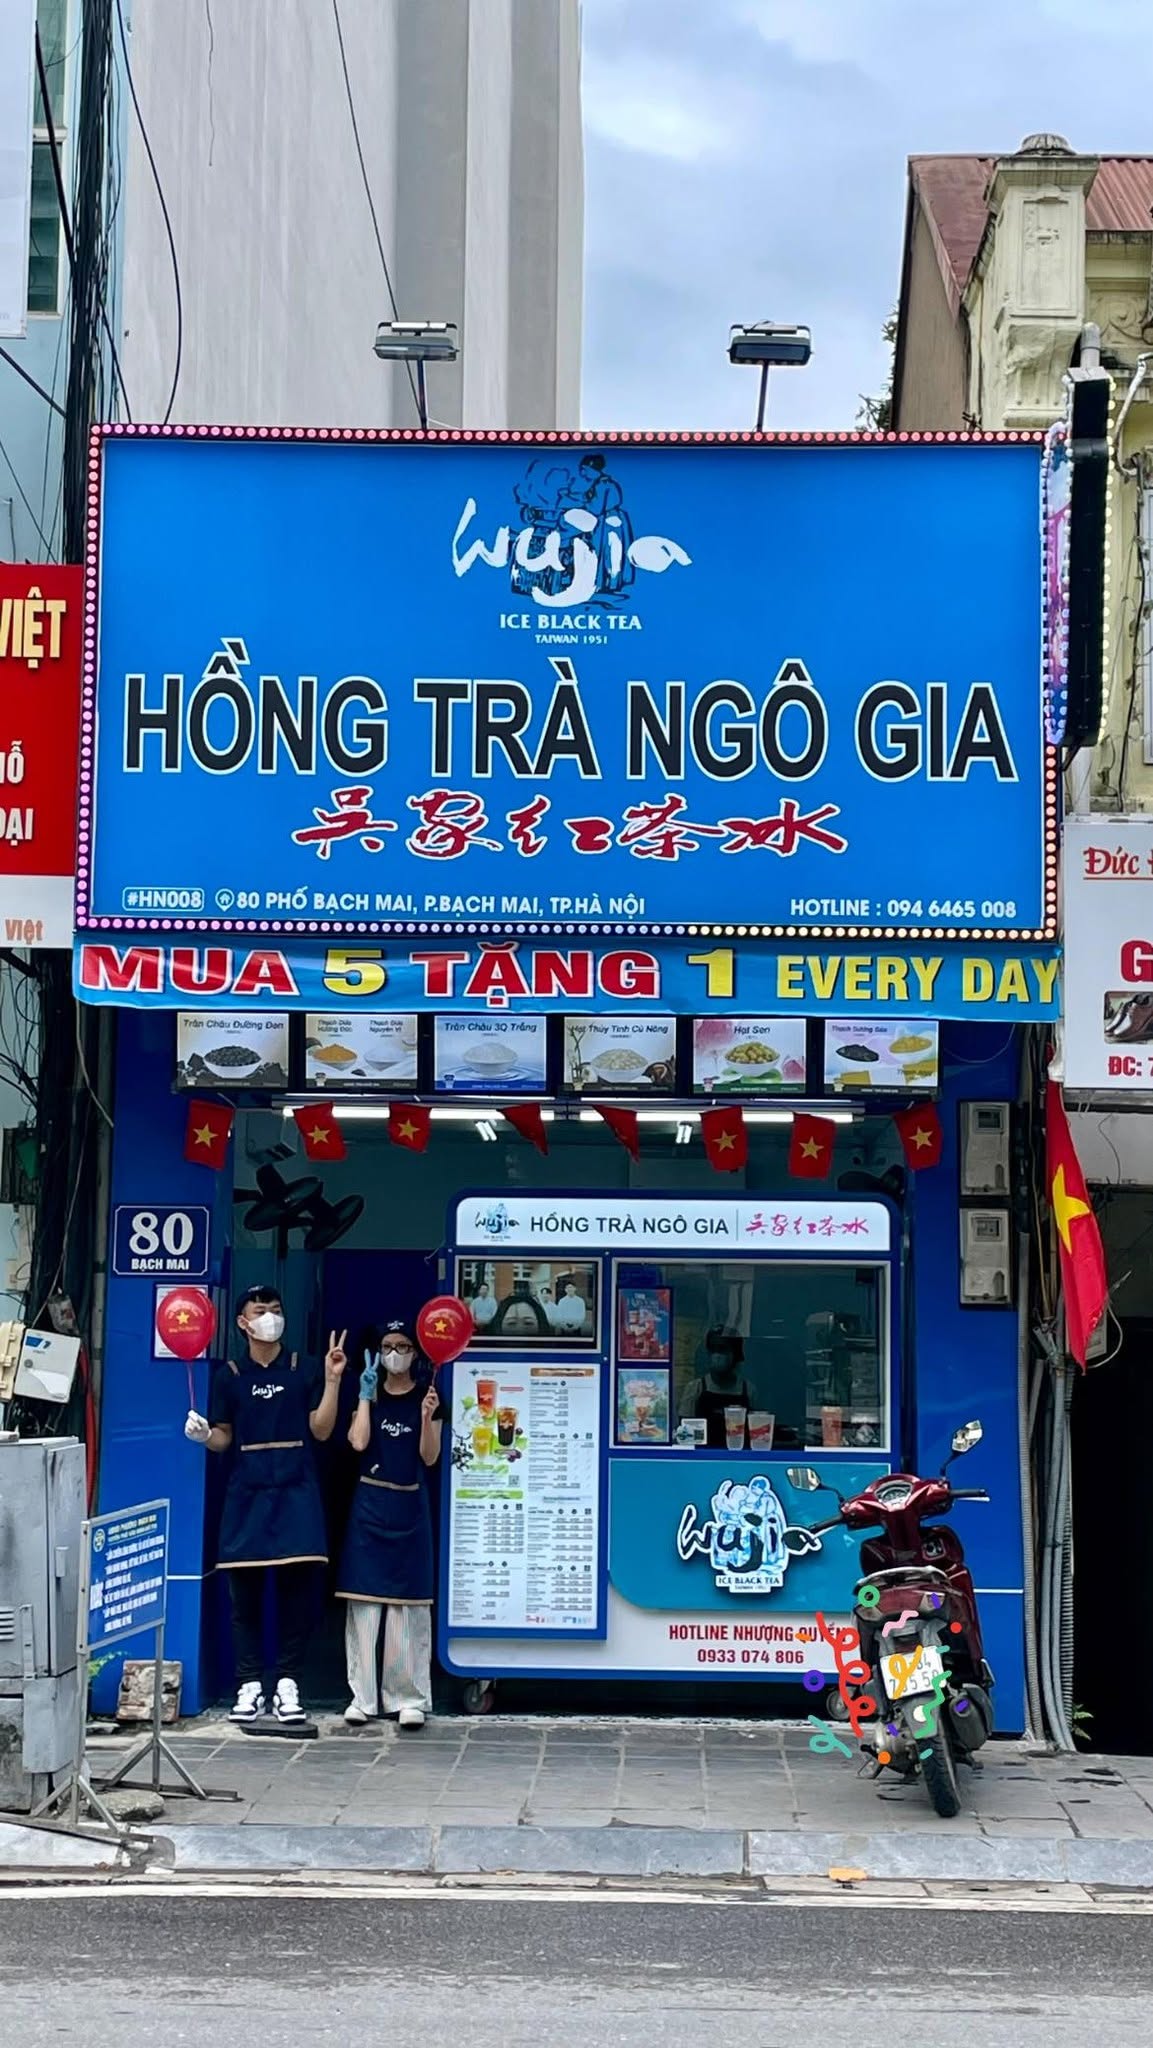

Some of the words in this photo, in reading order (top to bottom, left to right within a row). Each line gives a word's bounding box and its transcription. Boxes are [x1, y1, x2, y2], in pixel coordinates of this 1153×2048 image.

[500, 613, 531, 629] ICE
[537, 613, 601, 630] BLACK
[606, 614, 643, 631] TEA
[535, 633, 579, 644] TAIWAN
[583, 634, 608, 645] 1951
[123, 637, 389, 777] HỒNG
[413, 656, 602, 779] TRÀ
[626, 658, 829, 783] NGÔ
[854, 680, 1020, 783] GIA
[1083, 845, 1140, 875] Đức
[127, 890, 202, 909] #HN008
[235, 891, 260, 909] 80
[265, 886, 309, 909] PHỐ
[313, 893, 369, 915] BẠCH
[375, 894, 418, 915] MAI,
[423, 894, 496, 917] P.BẠCH
[501, 896, 544, 917] MAI,
[549, 892, 603, 915] TP.HÀ
[608, 892, 646, 920] NỘI
[790, 898, 870, 917] HOTLINE
[887, 899, 923, 918] 094
[928, 900, 976, 918] 6465
[981, 901, 1017, 919] 008
[78, 943, 300, 996] MUA
[322, 948, 388, 996] 5
[409, 941, 661, 1008] TẶNG
[686, 947, 735, 998] 1
[776, 955, 945, 1001] EVERY
[961, 956, 1059, 1004] DAY
[494, 1022, 508, 1033] 3Q
[733, 1025, 750, 1035] Hạt
[751, 1025, 771, 1034] Sen
[531, 1211, 589, 1233] HỒNG
[597, 1213, 636, 1233] TRÀ
[642, 1214, 688, 1234] NGÔ
[693, 1217, 729, 1235] GIA
[129, 1211, 194, 1256] 80
[131, 1258, 163, 1272] BẠCH
[166, 1259, 189, 1270] MAI
[734, 1577, 761, 1585] BLACK
[669, 1624, 729, 1640] HOTLINE
[733, 1624, 794, 1644] NHƯỢNG
[697, 1649, 736, 1663] 0933
[741, 1649, 770, 1664] 074
[775, 1650, 804, 1664] 806
